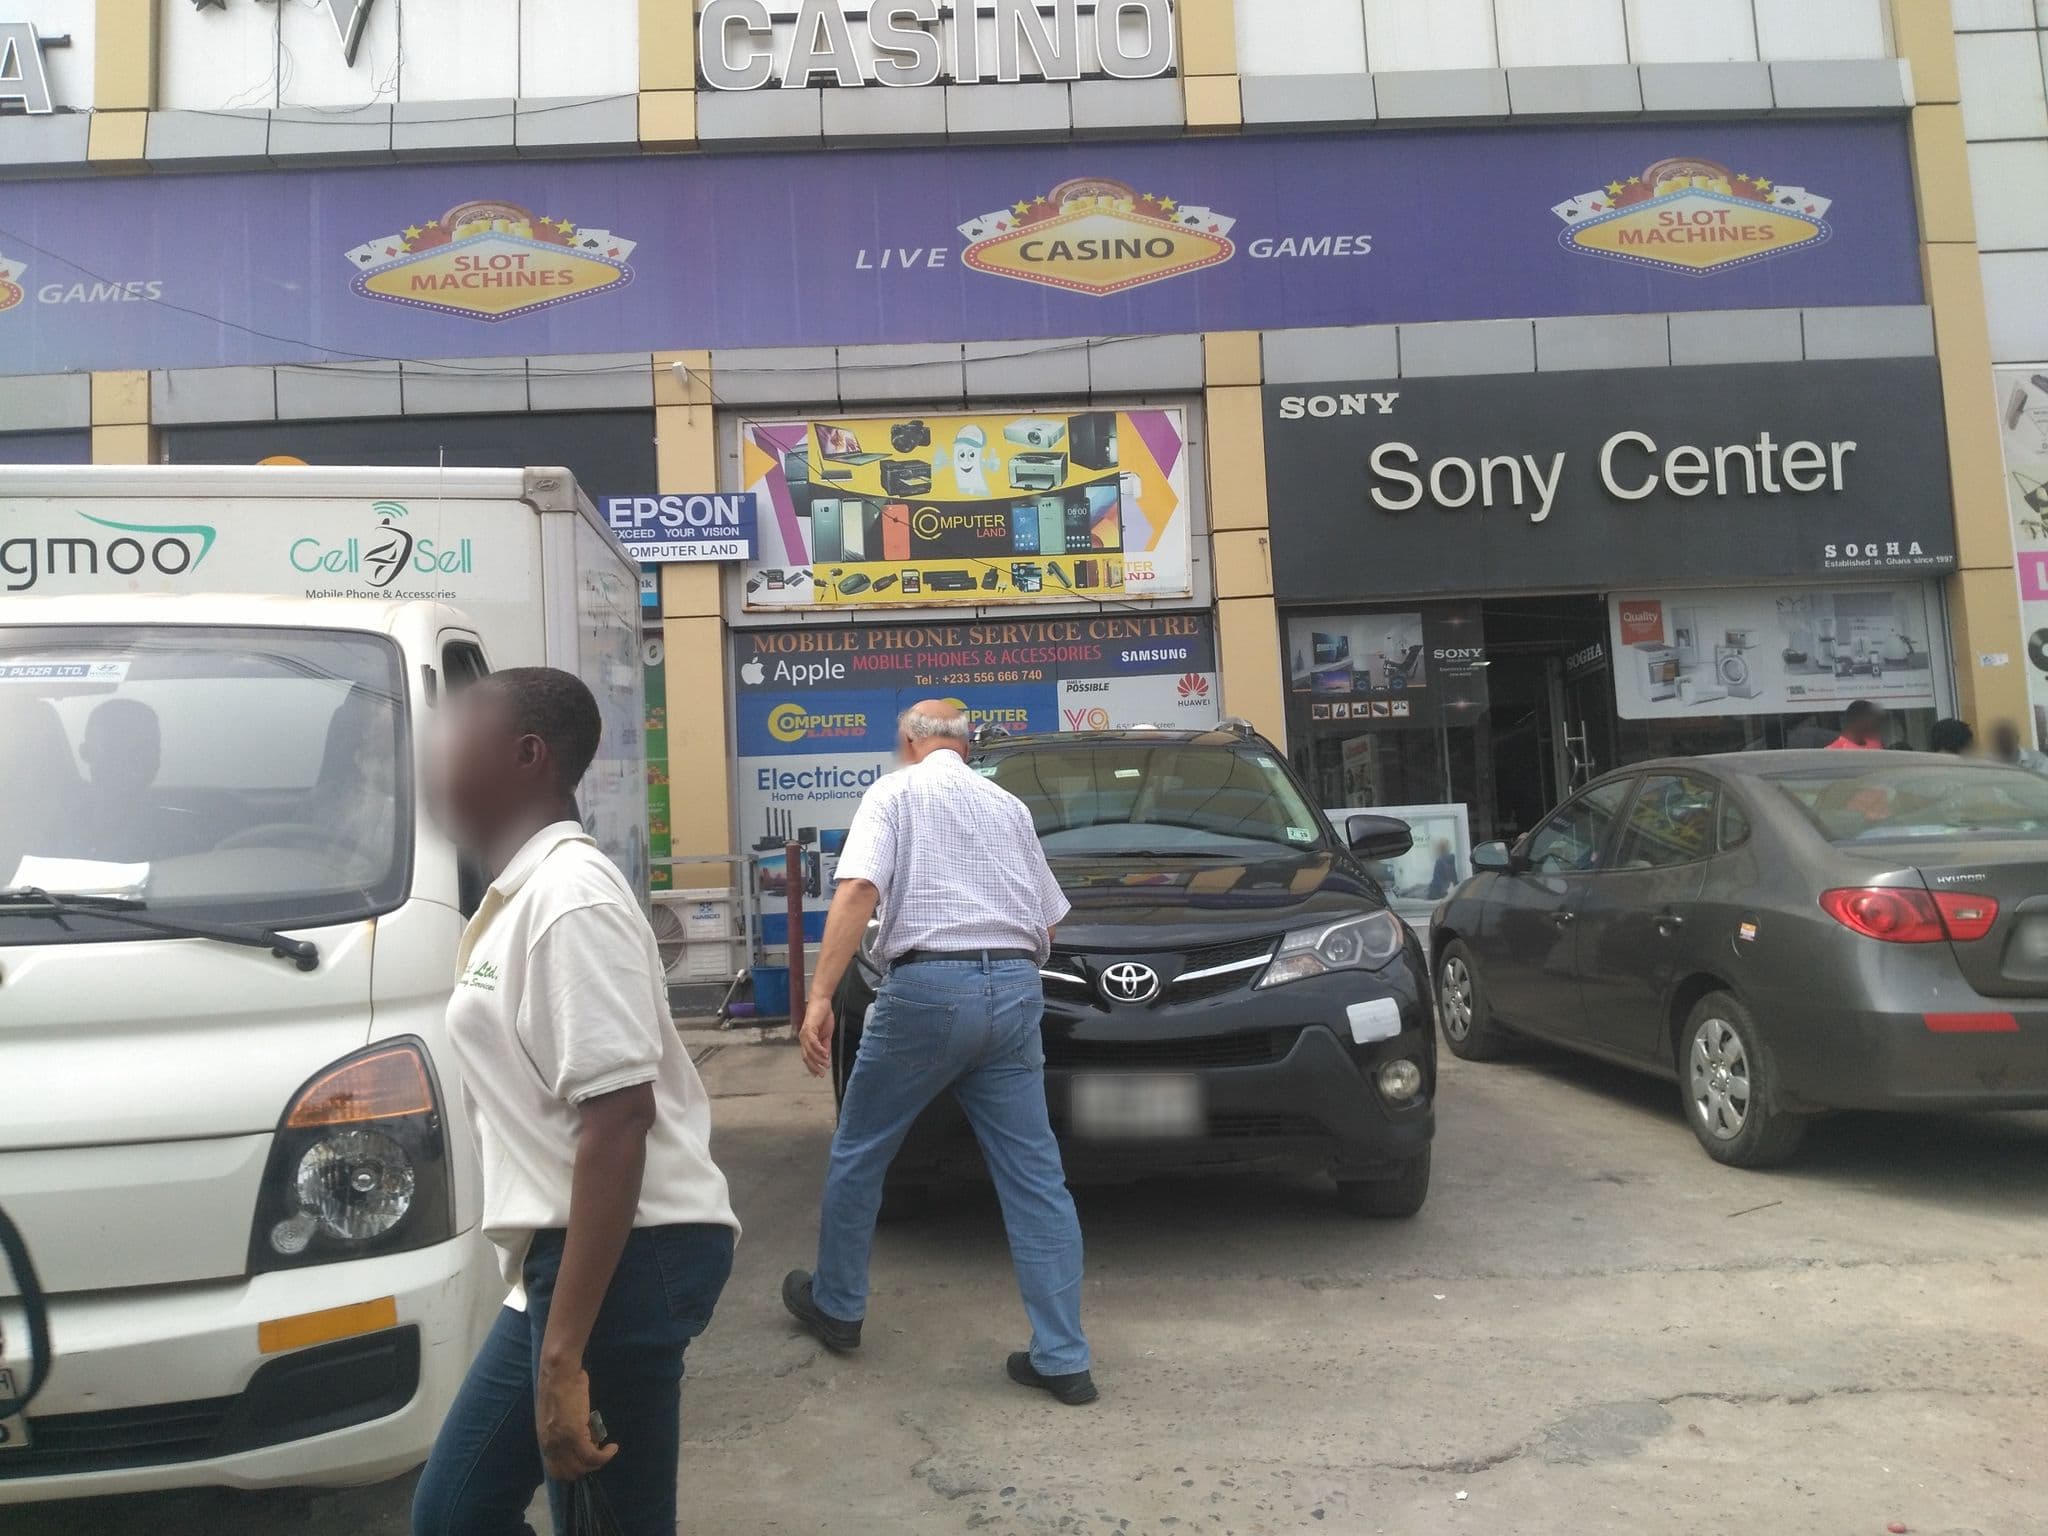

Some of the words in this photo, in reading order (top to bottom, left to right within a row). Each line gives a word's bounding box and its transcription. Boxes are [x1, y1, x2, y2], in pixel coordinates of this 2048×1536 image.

[700, 0, 1173, 90] CASINO
[1658, 209, 1731, 228] SLOT
[1618, 224, 1775, 246] MACHINES
[855, 247, 948, 269] LIVE
[1019, 236, 1175, 263] CASINO
[1248, 235, 1373, 259] GAMES
[453, 253, 531, 272] SLOT
[410, 268, 574, 292] MACHINES
[37, 280, 163, 304] GAMES
[1280, 392, 1399, 419] SONY
[1370, 441, 1566, 523] Sony
[1600, 430, 1857, 500] Center
[609, 495, 739, 527] EPSON
[664, 528, 695, 537] YOUR
[702, 527, 739, 537] VISION
[976, 528, 1006, 538] LAND
[290, 538, 359, 573] Cell
[414, 538, 472, 573] Sell
[629, 545, 697, 558] OMPUTER
[701, 544, 738, 555] LAND
[1825, 559, 1871, 568] Established
[1886, 557, 1911, 566] Ghana
[1914, 556, 1934, 564] since
[305, 590, 343, 599] Mobile
[346, 590, 380, 599] Phone
[383, 590, 393, 598] &
[395, 590, 457, 599] Accessories
[1623, 611, 1658, 624] Quality
[753, 631, 859, 654] MOBILE
[868, 628, 962, 650] PHONE
[969, 621, 1082, 645] SERVICE
[1088, 616, 1199, 640] CENTRE
[853, 653, 912, 671] MOBILE
[917, 651, 980, 668] PHONES
[984, 651, 996, 665] &
[1002, 645, 1101, 665] ACCESSORIES
[1121, 648, 1187, 662] SAMSUNG
[1433, 648, 1483, 659] SONY
[10, 666, 51, 676] PLAZA
[57, 666, 83, 675] LTD.
[773, 657, 846, 687] Apple
[915, 675, 932, 686] Tel
[942, 673, 970, 685] +233
[974, 673, 995, 683] 556
[997, 671, 1019, 682] 666
[1022, 670, 1043, 681] 740
[1066, 682, 1110, 693] POSSIBLE
[1177, 699, 1211, 708] HUAWEI
[806, 727, 866, 738] LAND
[758, 765, 881, 791] Electrical
[772, 792, 804, 802] Home
[807, 790, 867, 802] Appliance
[1937, 873, 1986, 883] HYUNDAI
[473, 960, 498, 980] Ltd.
